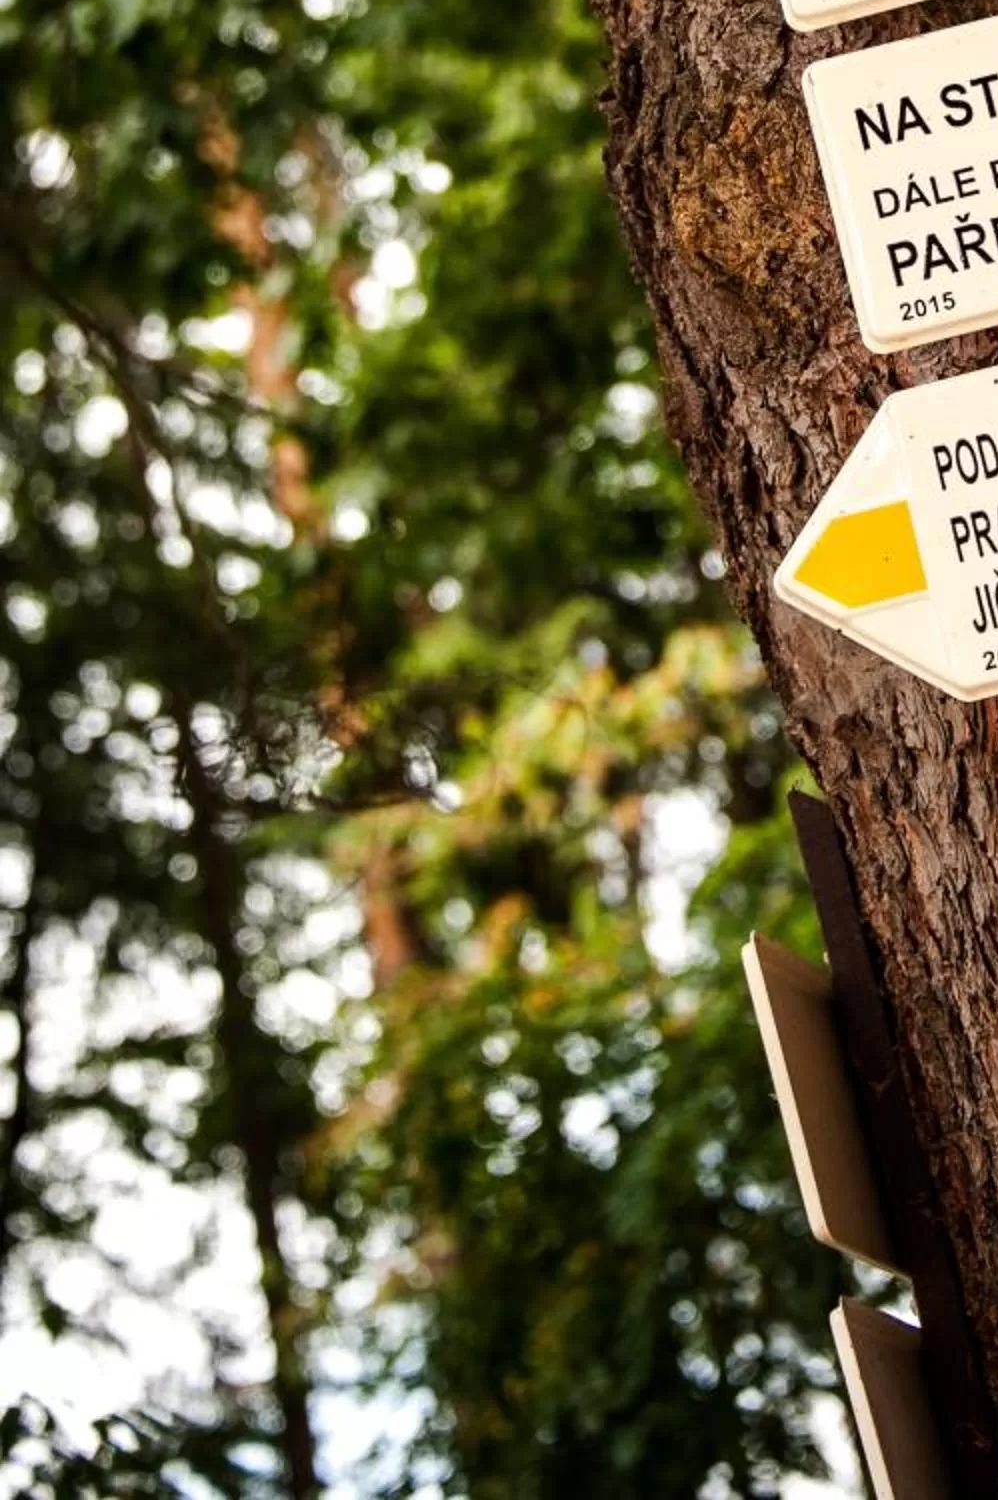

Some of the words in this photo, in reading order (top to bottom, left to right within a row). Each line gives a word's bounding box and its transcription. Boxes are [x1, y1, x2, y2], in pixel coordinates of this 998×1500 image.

[854, 95, 933, 151] NA
[872, 165, 981, 219] DÁLE
[899, 291, 956, 322] 2015
